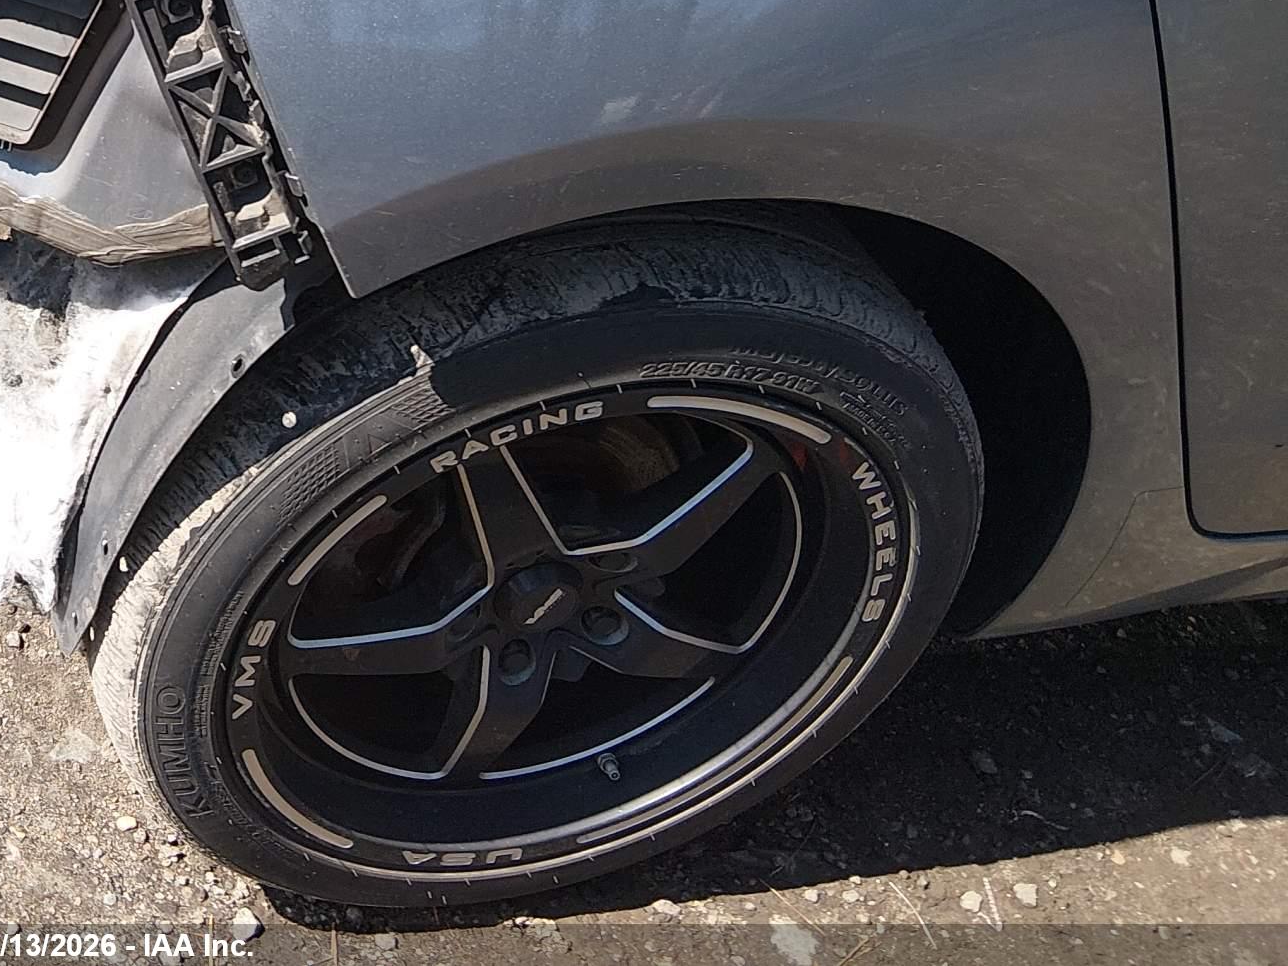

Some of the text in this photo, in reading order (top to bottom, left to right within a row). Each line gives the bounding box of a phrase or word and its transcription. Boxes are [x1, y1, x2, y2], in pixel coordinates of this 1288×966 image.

[429, 400, 604, 474] RACING
[851, 461, 897, 622] WHEELS
[231, 619, 277, 721] VMS
[153, 685, 215, 819] KUMHO
[401, 847, 524, 867] USA
